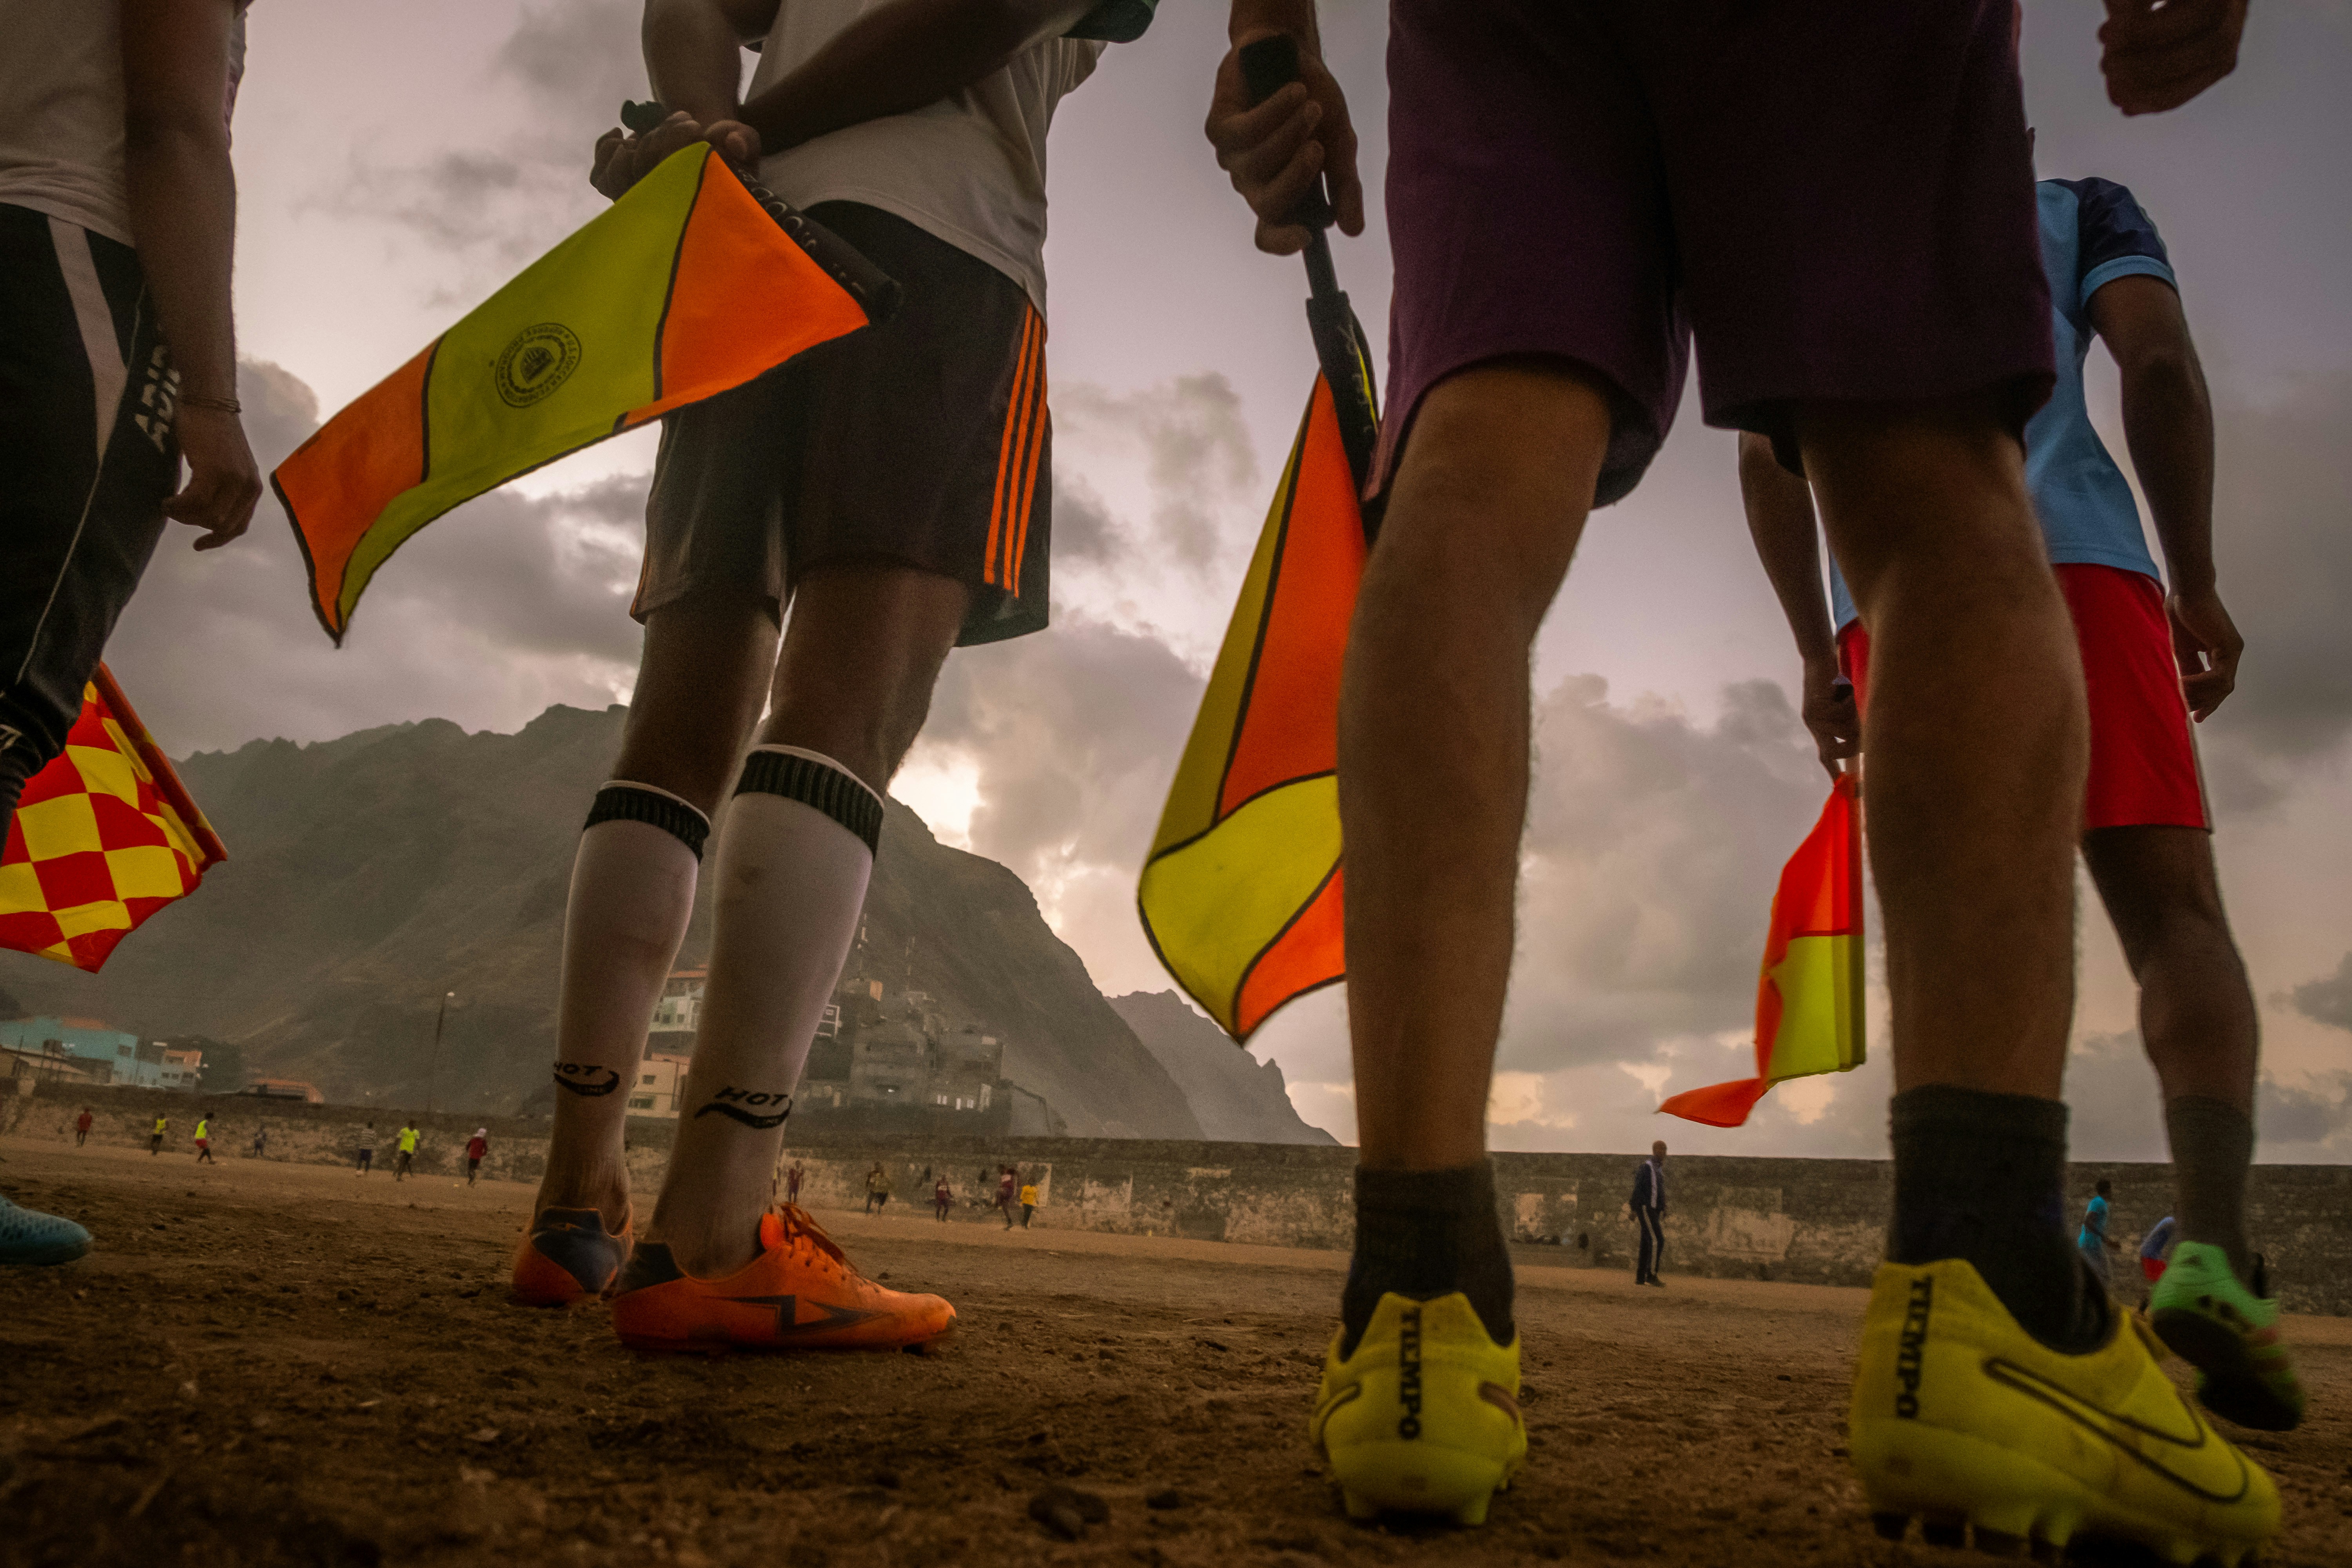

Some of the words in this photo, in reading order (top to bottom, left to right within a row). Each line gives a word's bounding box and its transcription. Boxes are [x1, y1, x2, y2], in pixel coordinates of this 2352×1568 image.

[715, 1085, 788, 1106] HOT
[1399, 1307, 1422, 1441] TIEMPO
[1896, 1274, 1935, 1420] TIEMPO
